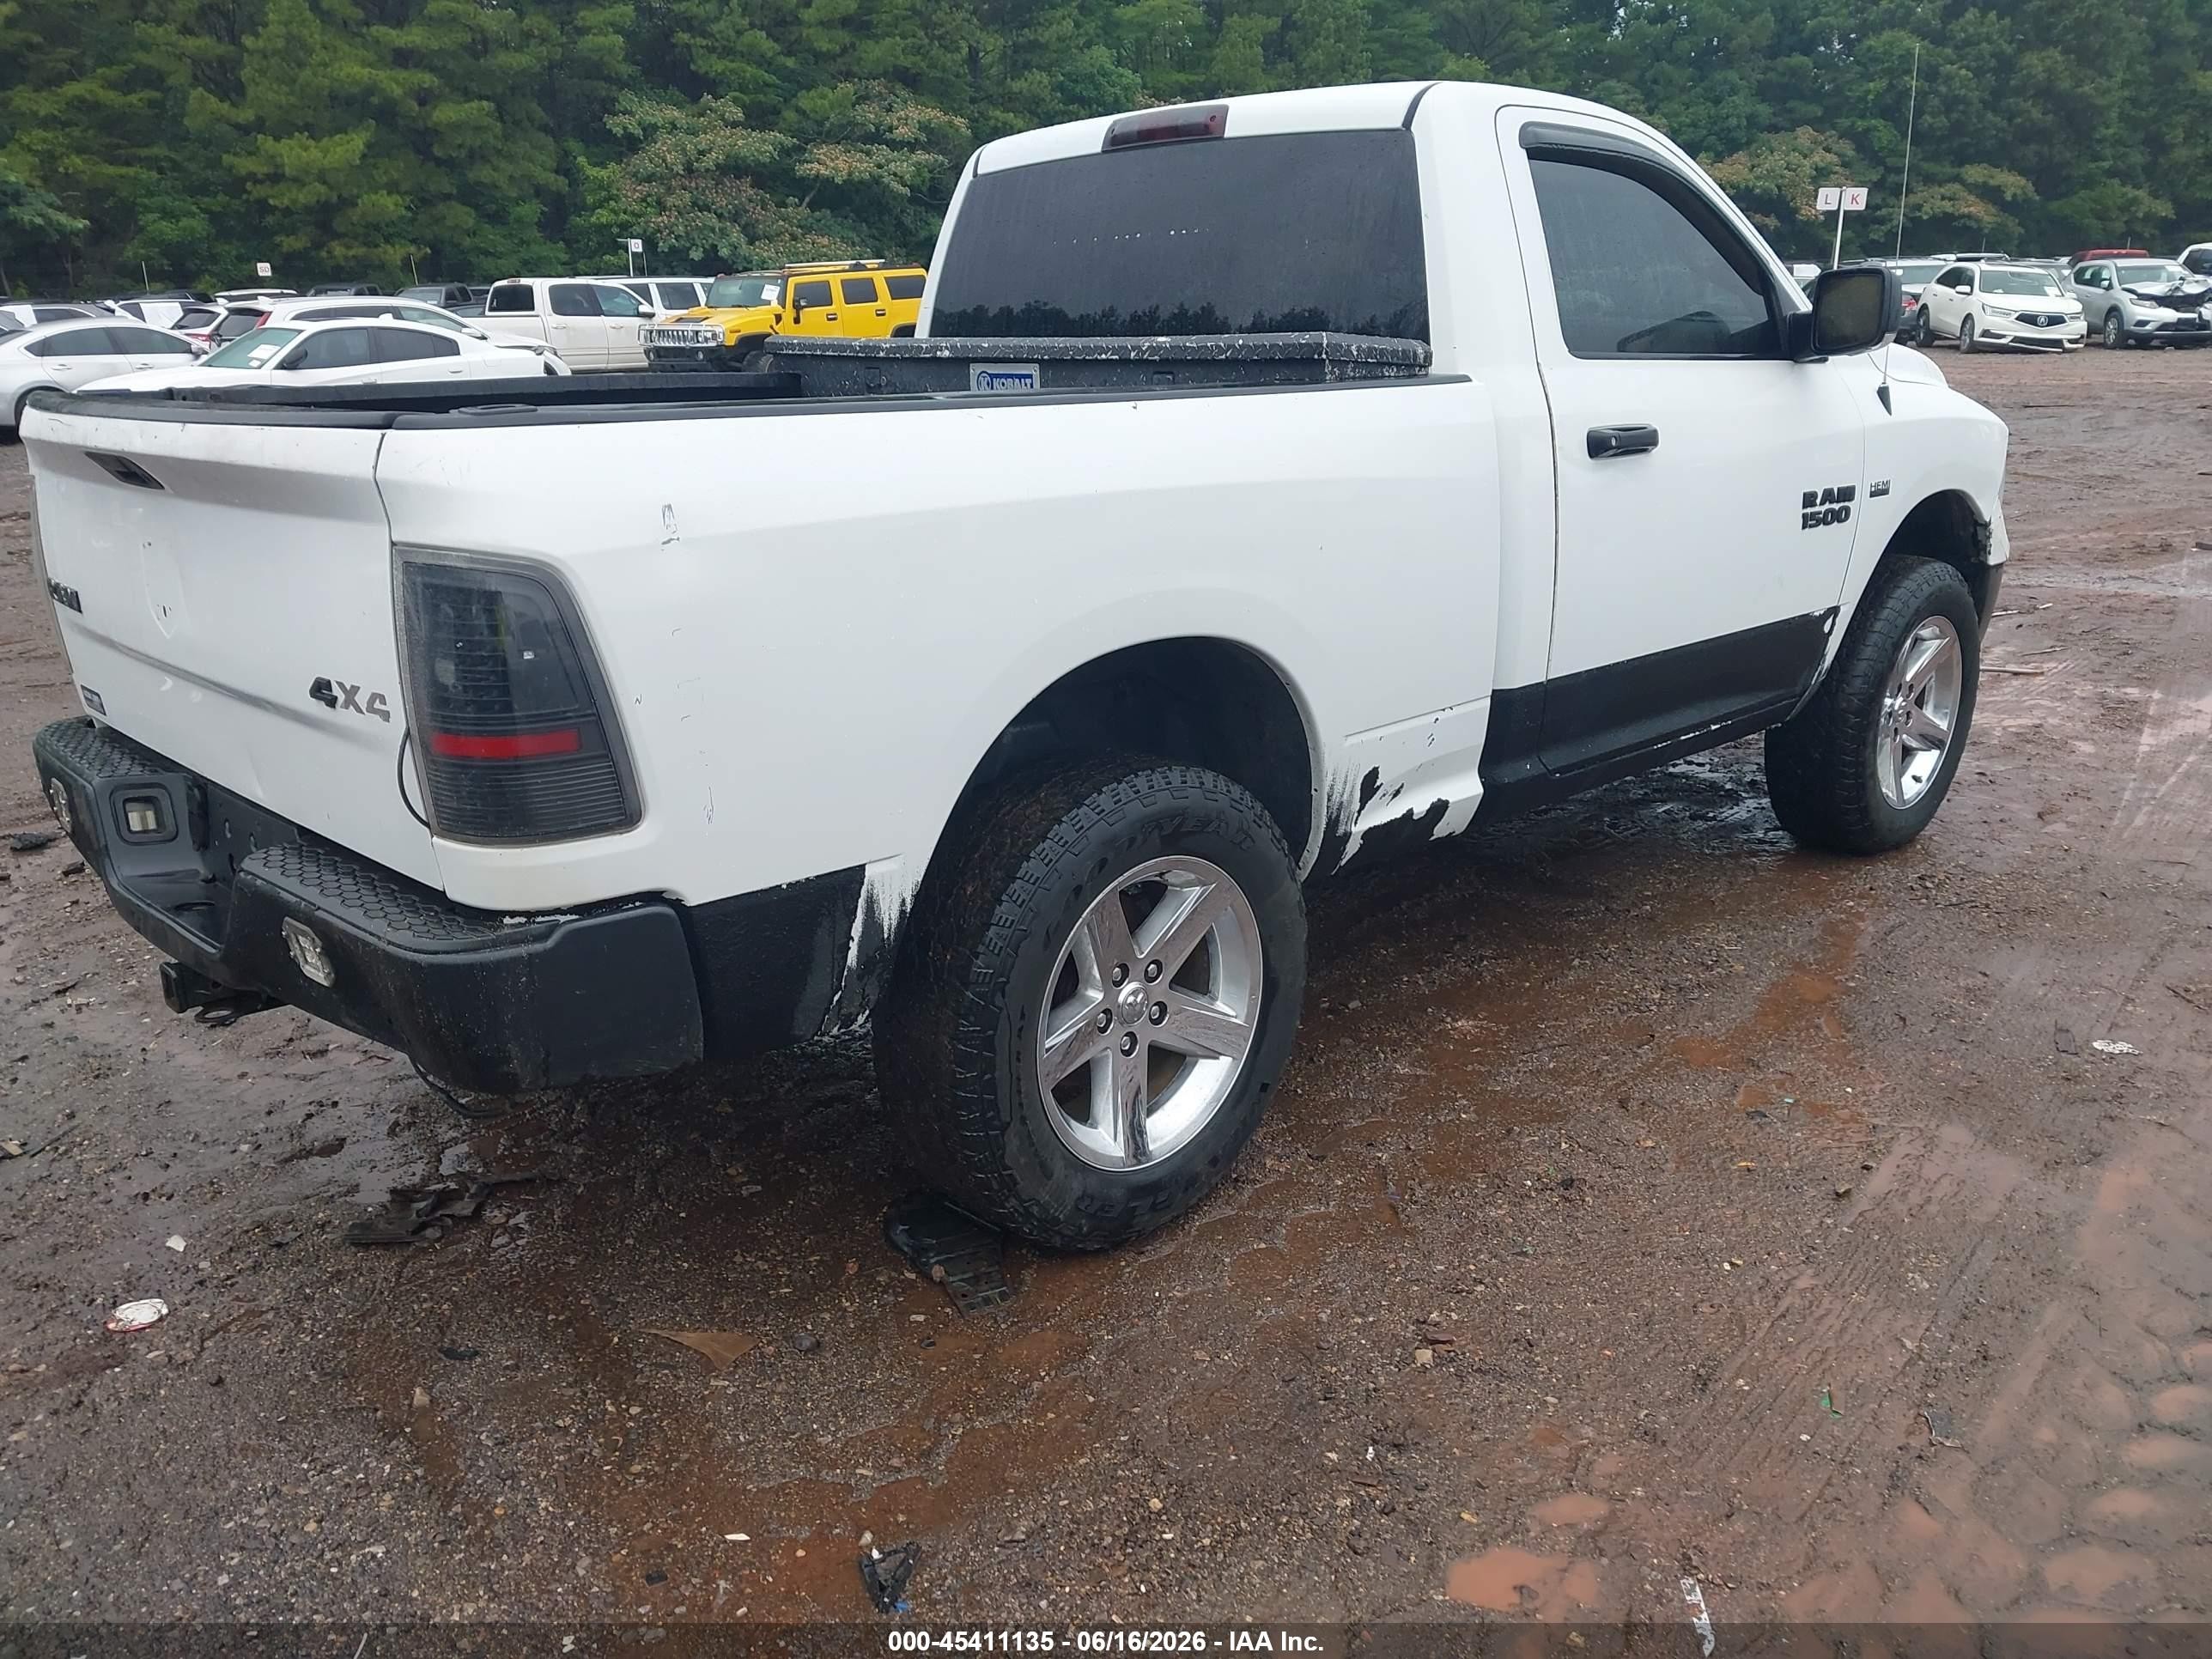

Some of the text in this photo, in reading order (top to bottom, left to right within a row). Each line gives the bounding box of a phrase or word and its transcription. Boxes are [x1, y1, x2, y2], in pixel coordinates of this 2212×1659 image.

[1825, 193, 1832, 205] L
[1850, 193, 1860, 205] K
[993, 377, 1032, 392] KOBALT
[1869, 478, 1891, 494] HEMI
[1802, 484, 1856, 510] RAM
[1801, 505, 1851, 531] 1500
[308, 677, 391, 723] 4X4
